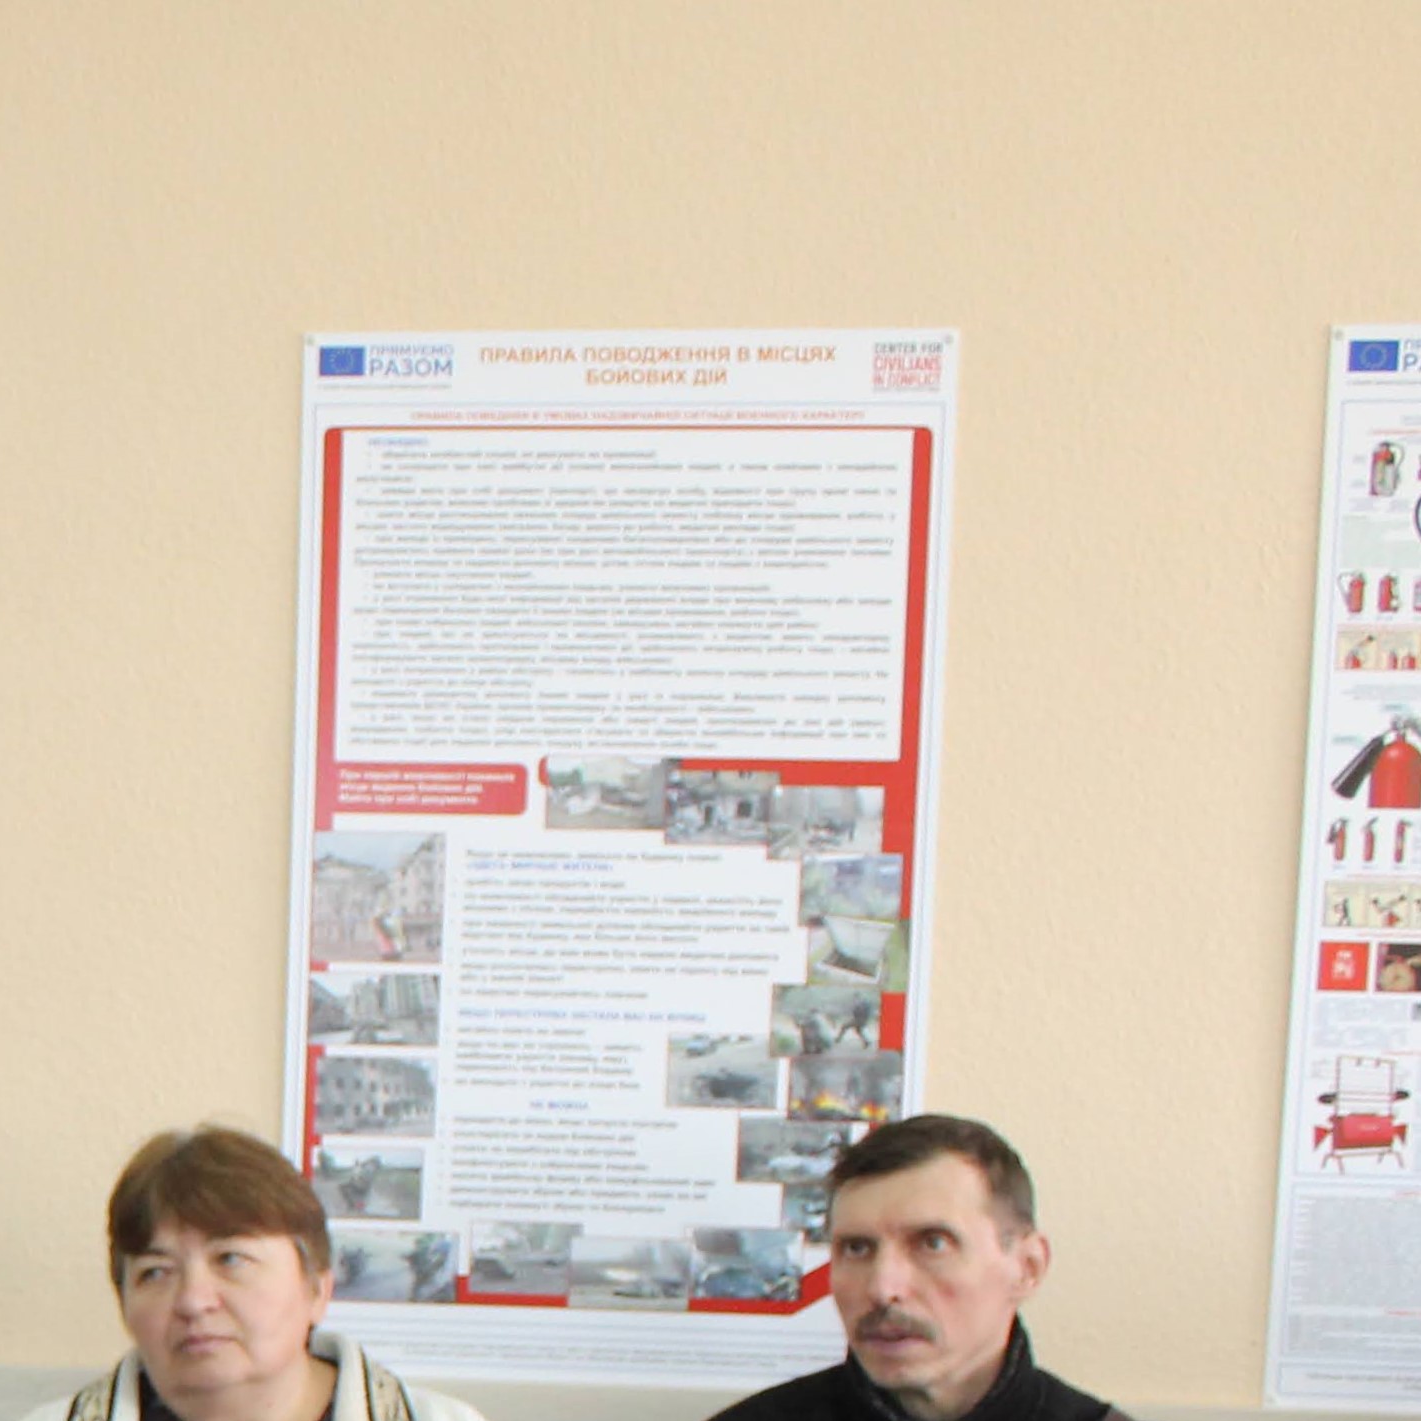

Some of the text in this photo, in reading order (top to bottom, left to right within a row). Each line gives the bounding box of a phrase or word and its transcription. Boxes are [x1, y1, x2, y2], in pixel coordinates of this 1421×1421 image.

[480, 346, 837, 364] ПРАВИЛА ПОВОДЖЕННЯ В МІСЦЯХ
[369, 358, 454, 376] РАЗОМ
[586, 367, 727, 387] БОЙОВИХ ДІЙ
